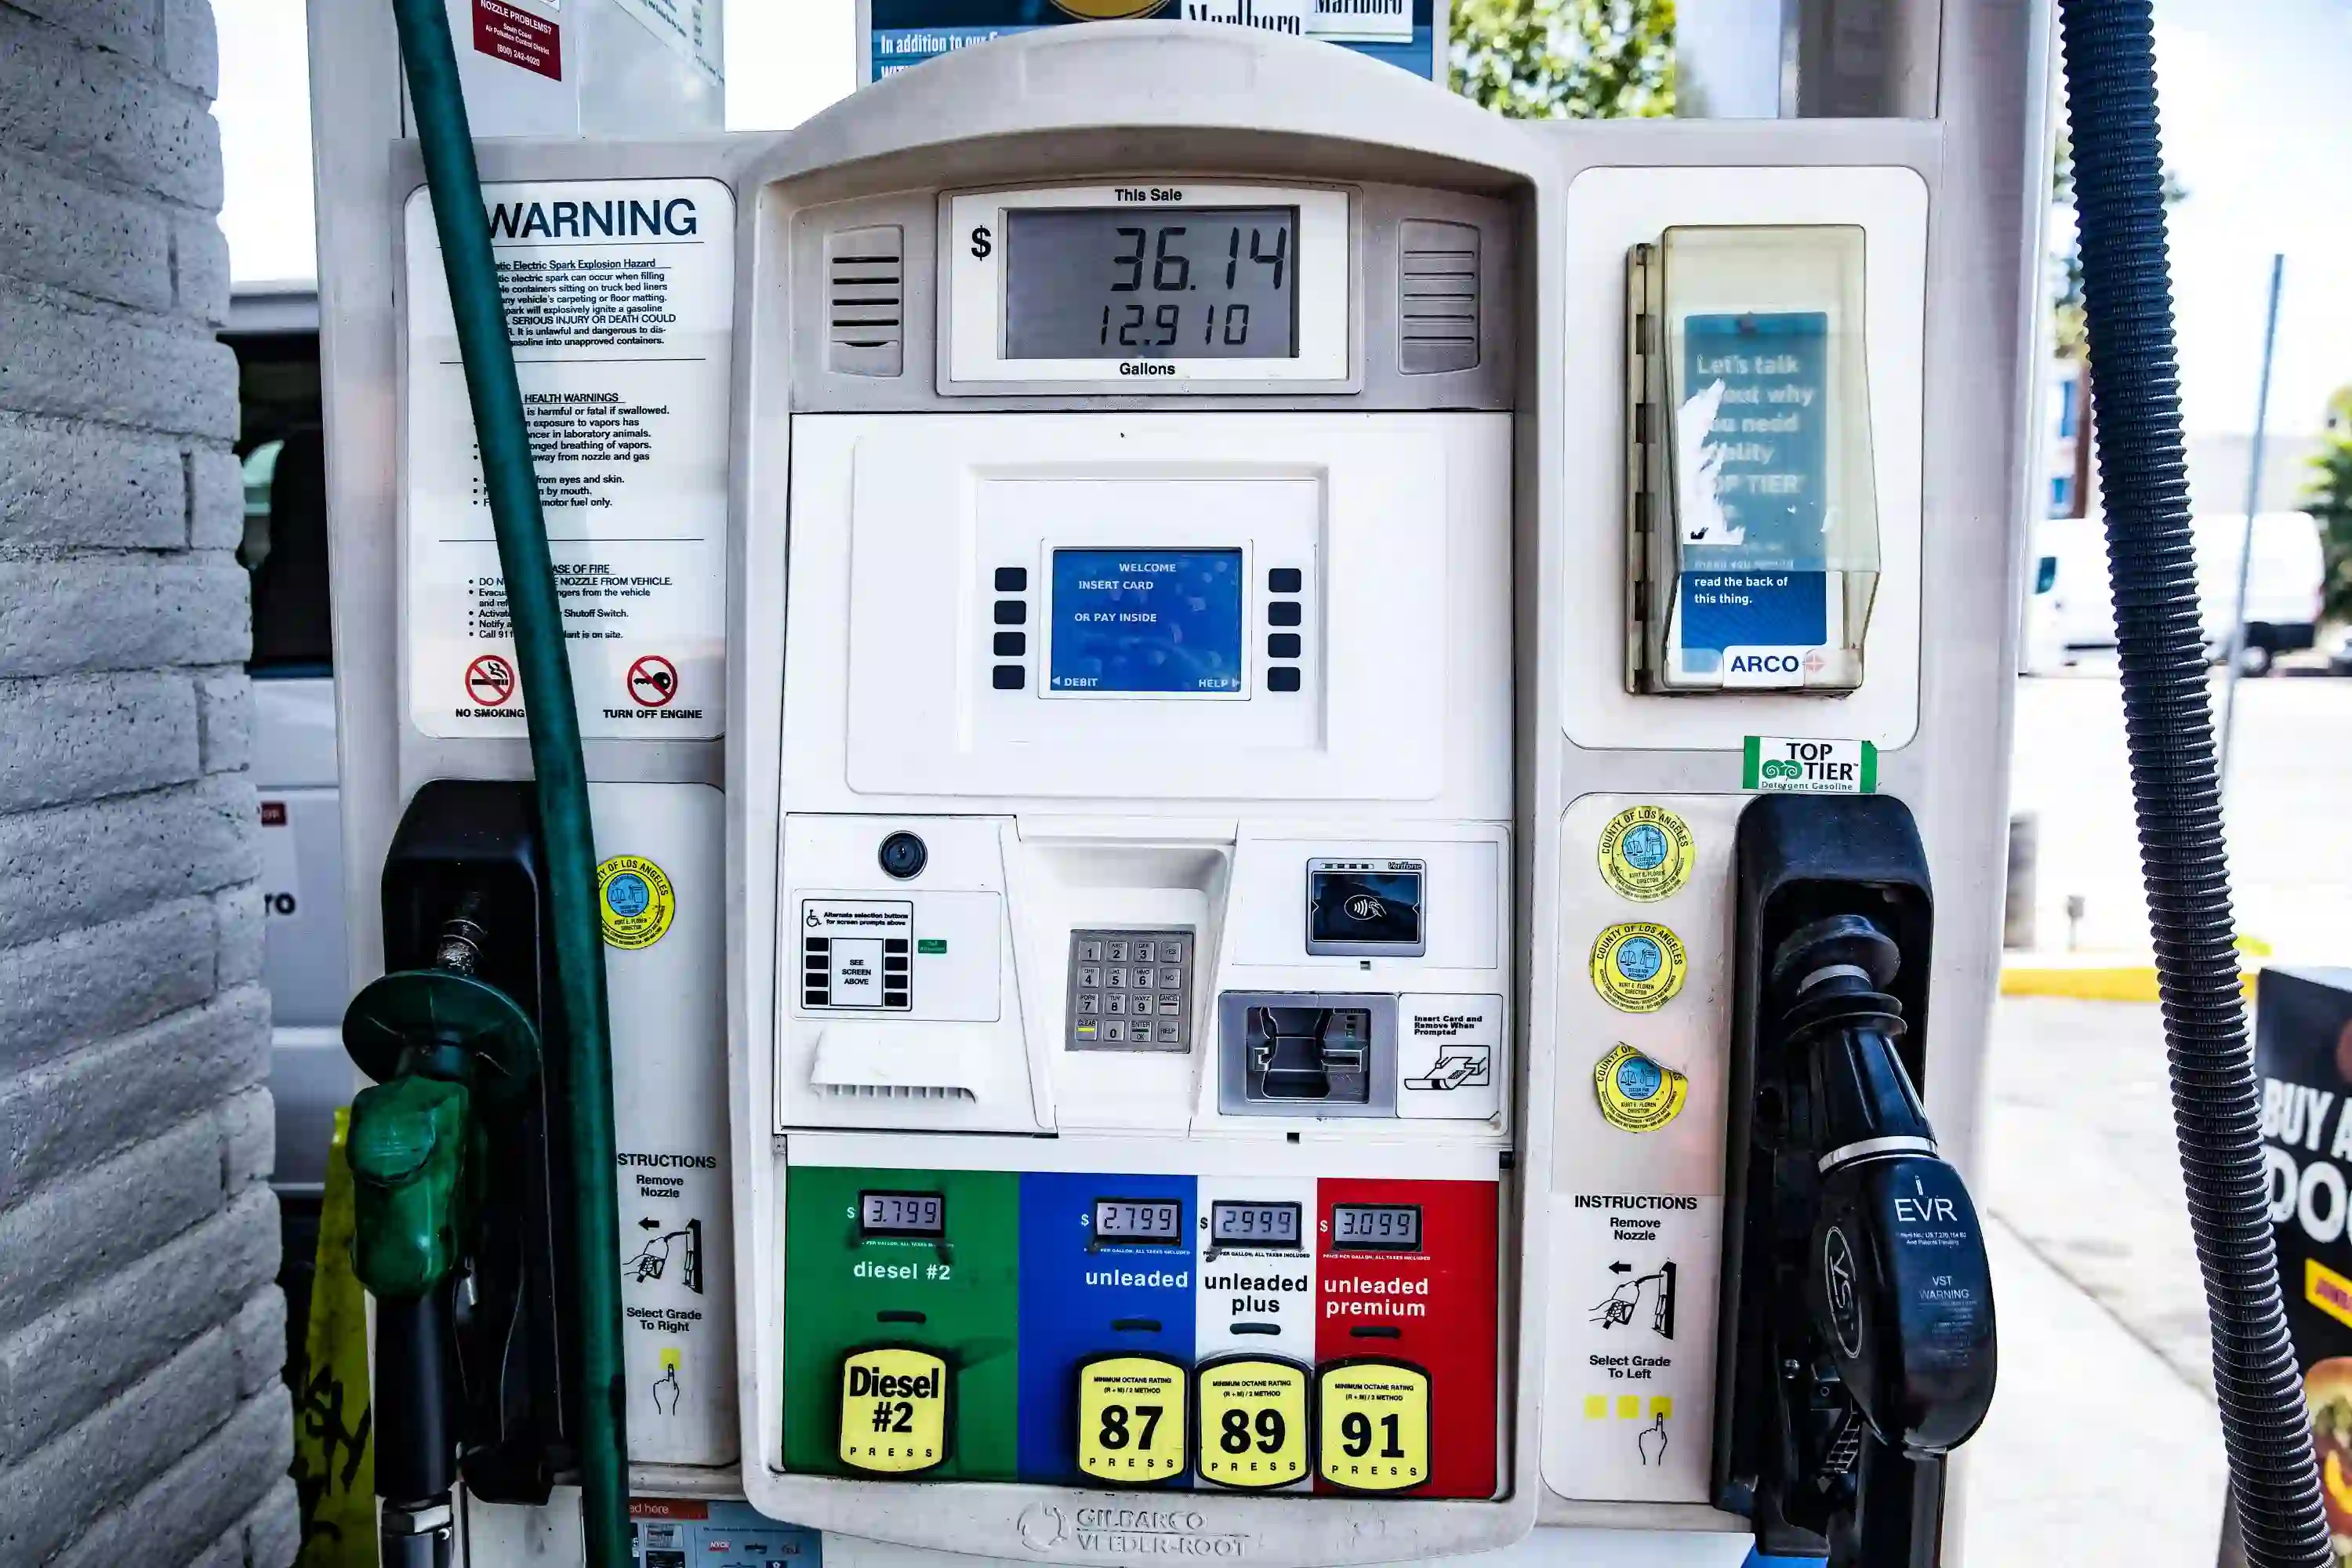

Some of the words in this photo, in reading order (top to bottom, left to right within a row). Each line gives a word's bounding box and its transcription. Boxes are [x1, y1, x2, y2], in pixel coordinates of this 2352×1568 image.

[481, 0, 508, 17] NOZZLE
[510, 11, 551, 34] PROBLEMS?
[494, 27, 514, 41] Pollution
[516, 36, 532, 49] Control
[881, 34, 893, 54] In
[896, 34, 947, 53] addition
[497, 44, 512, 57] (800)
[514, 50, 539, 66] 242-4020
[1115, 189, 1146, 201] This
[1150, 189, 1182, 201] Sale
[490, 198, 697, 239] WARNING
[971, 225, 991, 260] $
[514, 261, 547, 270] Electric
[550, 260, 575, 269] Spark
[579, 260, 622, 269] Explosion
[624, 259, 657, 268] Hazard
[1110, 227, 1287, 292] 36.14
[546, 274, 568, 283] spark
[641, 272, 664, 281] filling
[512, 285, 557, 294] containers
[559, 285, 585, 293] sitting
[512, 316, 554, 325] SERIOUS
[557, 315, 590, 324] INJURY
[592, 315, 605, 324] OR
[642, 314, 676, 322] COULD
[1101, 304, 1249, 346] 12.910
[1120, 362, 1176, 376] Gallons
[1697, 354, 1749, 374] Let's
[1755, 354, 1799, 374] talk
[524, 394, 561, 402] HEALTH
[564, 393, 619, 402] WARNINGS
[1767, 383, 1814, 407] why
[538, 407, 572, 416] harmful
[586, 406, 607, 415] fatal
[610, 406, 615, 415] if
[618, 405, 669, 415] swallowed.
[1742, 412, 1798, 432] need
[553, 430, 561, 438] in
[564, 430, 611, 439] laboratory
[613, 429, 651, 437] animals.
[573, 564, 586, 573] OF
[590, 564, 609, 573] FIRE
[1119, 564, 1176, 572] WELCOME
[1079, 581, 1120, 590] INSERT
[1123, 581, 1153, 590] CARD
[1694, 576, 1721, 587] read
[1725, 576, 1743, 587] the
[1746, 576, 1773, 587] back
[1777, 576, 1788, 587] of
[1694, 593, 1715, 604] this
[1719, 593, 1753, 606] thing.
[480, 620, 505, 630] Notify
[1075, 613, 1091, 622] OR
[1094, 613, 1116, 622] PAY
[1120, 613, 1157, 622] INSIDE
[1730, 655, 1799, 673] ARCO
[1064, 677, 1098, 687] DEBIT
[1199, 679, 1228, 688] HELP
[456, 709, 471, 717] NO
[474, 709, 524, 717] SMOKING
[603, 710, 633, 718] TURN
[637, 710, 658, 718] OFF
[661, 710, 702, 718] ENGINE
[1786, 742, 1833, 760] TOP
[1804, 762, 1853, 781] TIER
[1762, 781, 1809, 791] Detergent
[1602, 820, 1624, 854] COUNTY
[1624, 812, 1635, 823] OF
[1639, 809, 1657, 819] LOS
[1659, 813, 1689, 848] ANGELES
[1388, 862, 1422, 870] Verifone
[1597, 927, 1621, 960] COUNTY
[1657, 930, 1682, 965] ANGELES
[2262, 1077, 2334, 1151] BUY
[618, 1153, 716, 1168] STRUCTIONS
[637, 1174, 684, 1186] Remove
[641, 1187, 680, 1198] Nozzle
[1574, 1196, 1697, 1210] INSTRUCTIONS
[1894, 1199, 1958, 1221] EVR
[872, 1200, 938, 1224] 3.799
[1104, 1207, 1171, 1230] 2.799
[1223, 1210, 1291, 1234] 2.999
[1342, 1212, 1410, 1236] 3.099
[1610, 1218, 1661, 1229] Remove
[1614, 1230, 1656, 1241] Nozzle
[854, 1262, 918, 1279] diesel
[926, 1264, 951, 1280] #2
[1086, 1269, 1189, 1288] unleaded
[1204, 1273, 1308, 1292] unleaded
[1324, 1277, 1428, 1295] unleaded
[1932, 1276, 1952, 1286] VST
[1919, 1289, 1969, 1299] WARNING
[627, 1307, 663, 1319] Select
[666, 1308, 702, 1319] Grade
[1232, 1295, 1279, 1315] plus
[1327, 1299, 1425, 1318] premium
[640, 1321, 655, 1330] To
[658, 1321, 689, 1332] Right
[1590, 1356, 1629, 1367] Select
[1632, 1356, 1671, 1367] Grade
[1608, 1368, 1623, 1378] To
[1627, 1368, 1651, 1379] Left
[850, 1366, 939, 1399] Diesel
[872, 1401, 913, 1433] #2
[1099, 1405, 1163, 1450] 87
[1220, 1409, 1286, 1454] 89
[1341, 1412, 1405, 1458] 91
[1076, 1508, 1208, 1530] GILBARCO
